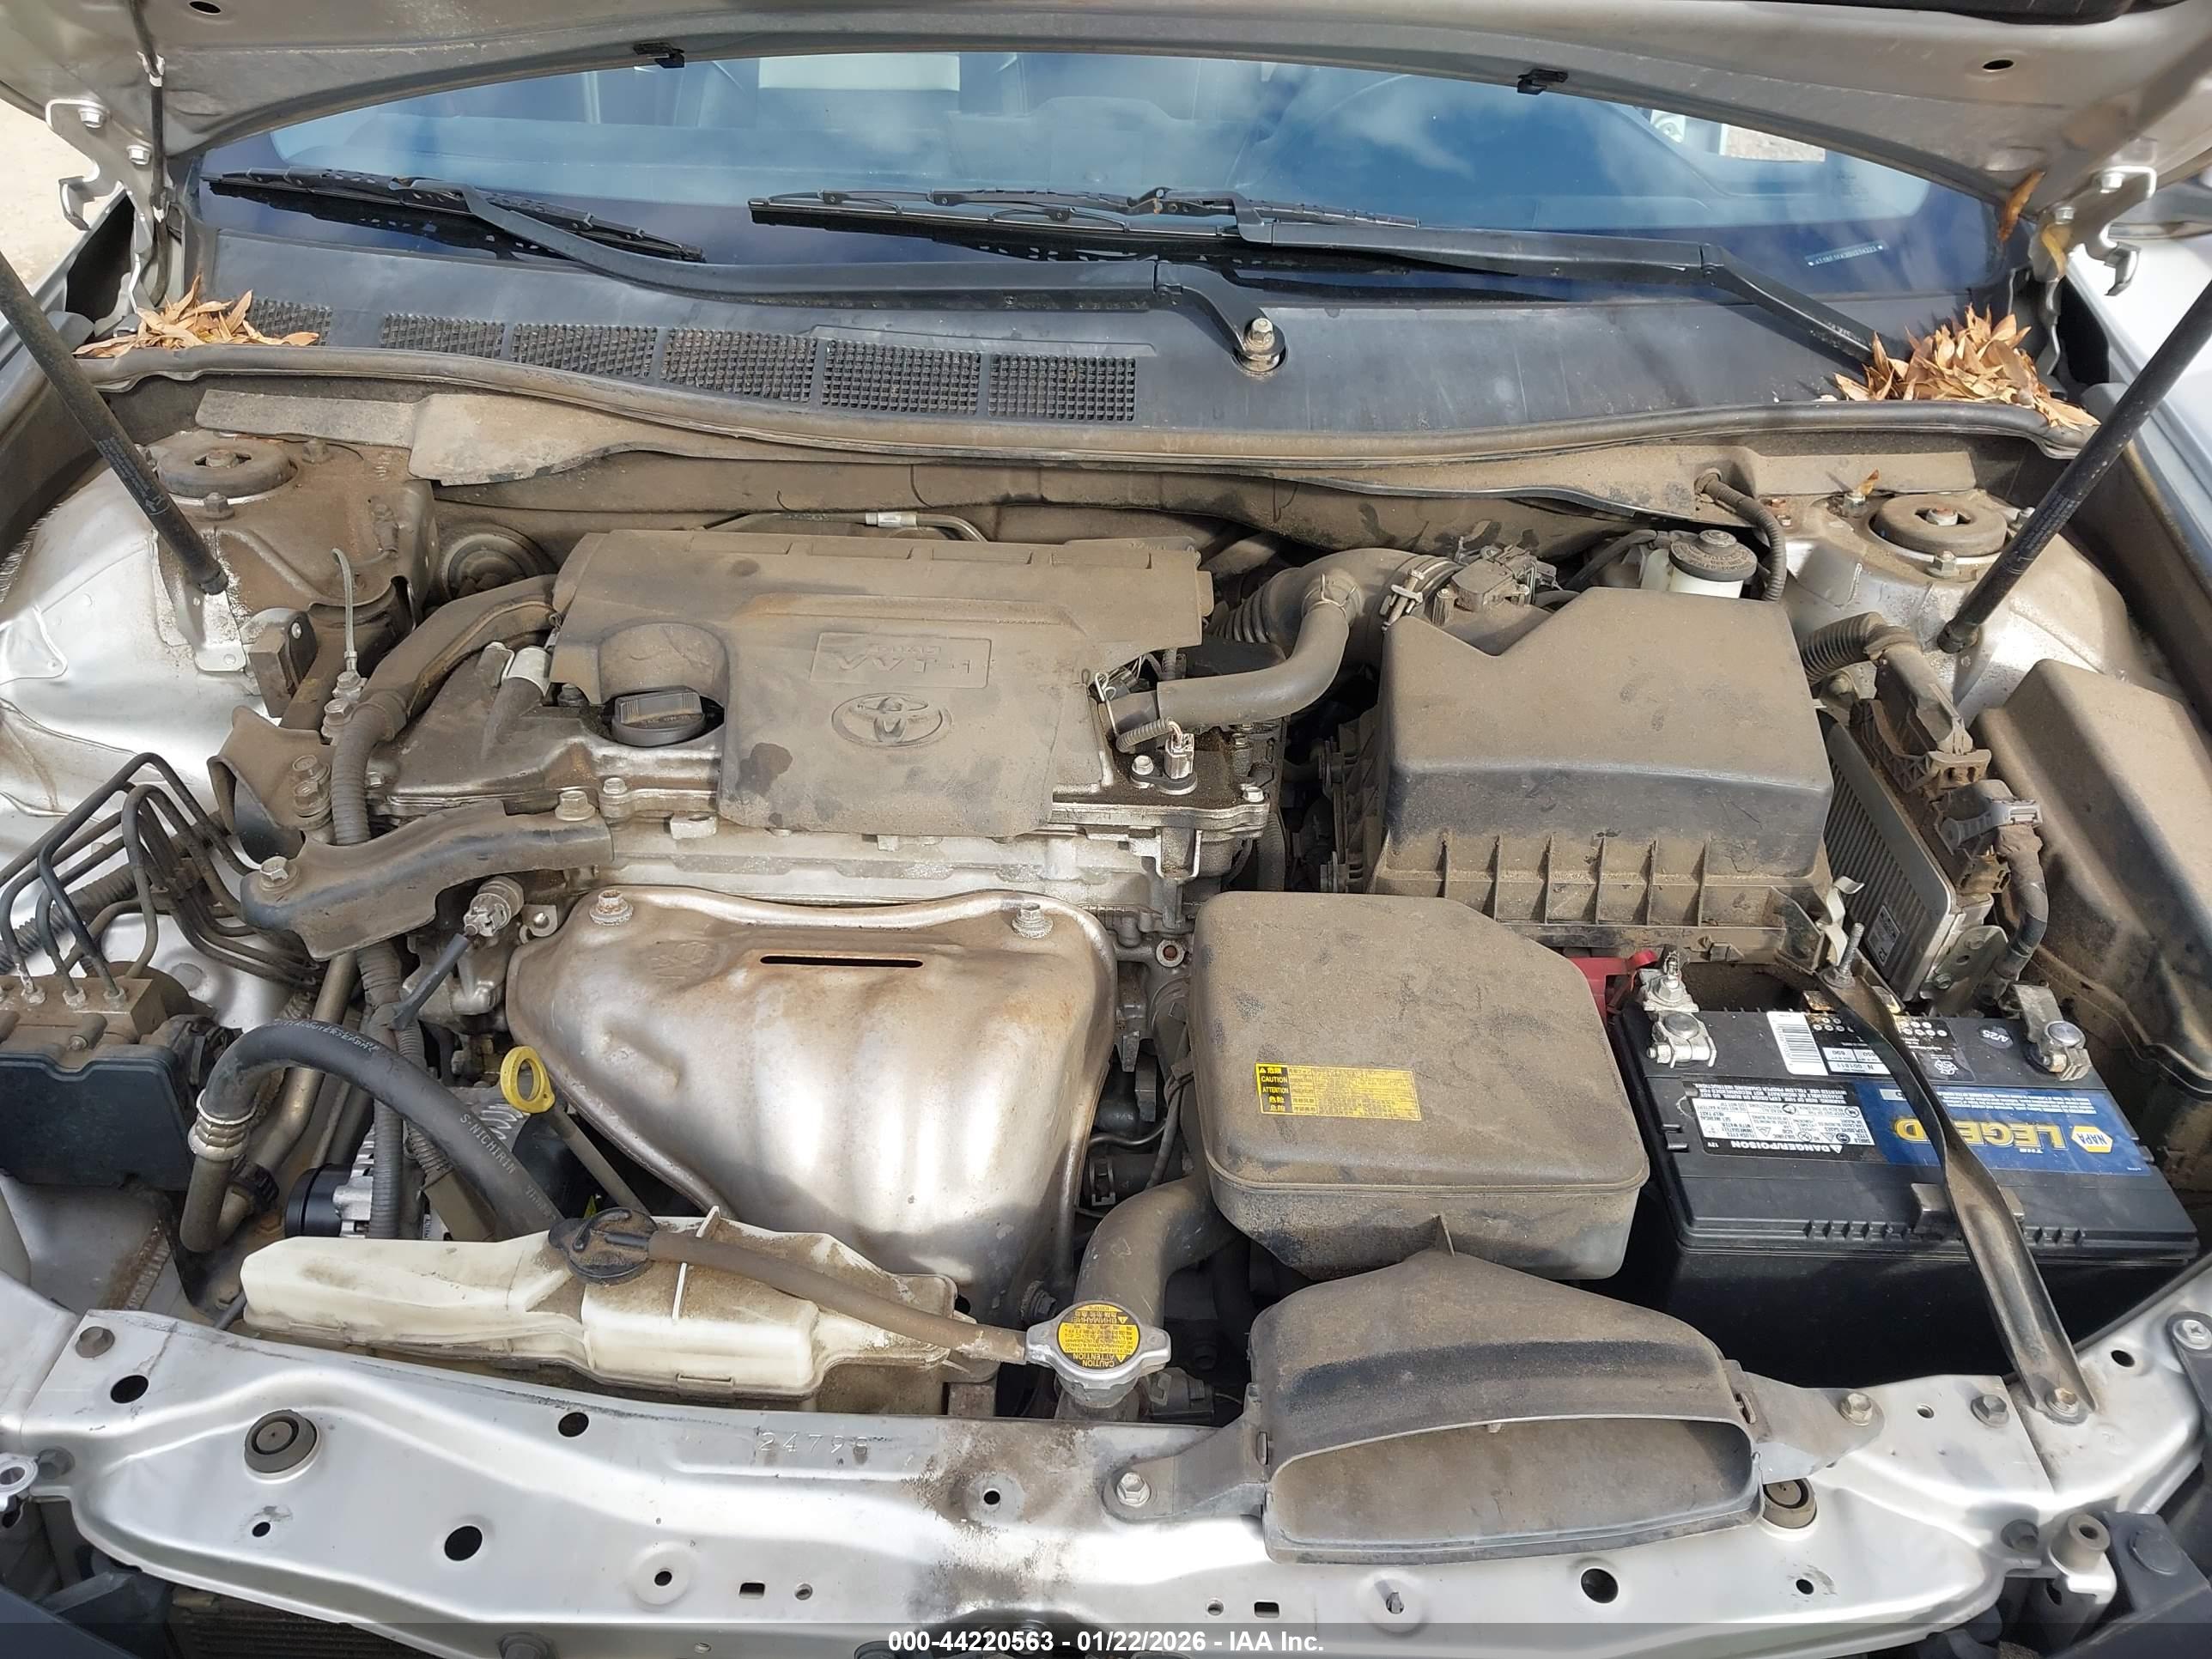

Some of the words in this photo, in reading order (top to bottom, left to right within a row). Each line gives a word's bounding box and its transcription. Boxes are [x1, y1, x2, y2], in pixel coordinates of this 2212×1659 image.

[1982, 1030, 2008, 1043] 4/25
[1261, 1075, 1288, 1084] CAUTION
[1894, 1119, 2065, 1151] LEGED
[2076, 1133, 2107, 1146] NAPA
[1730, 1140, 1831, 1152] DANGER/POISON
[1082, 1359, 1115, 1368] CAUTION
